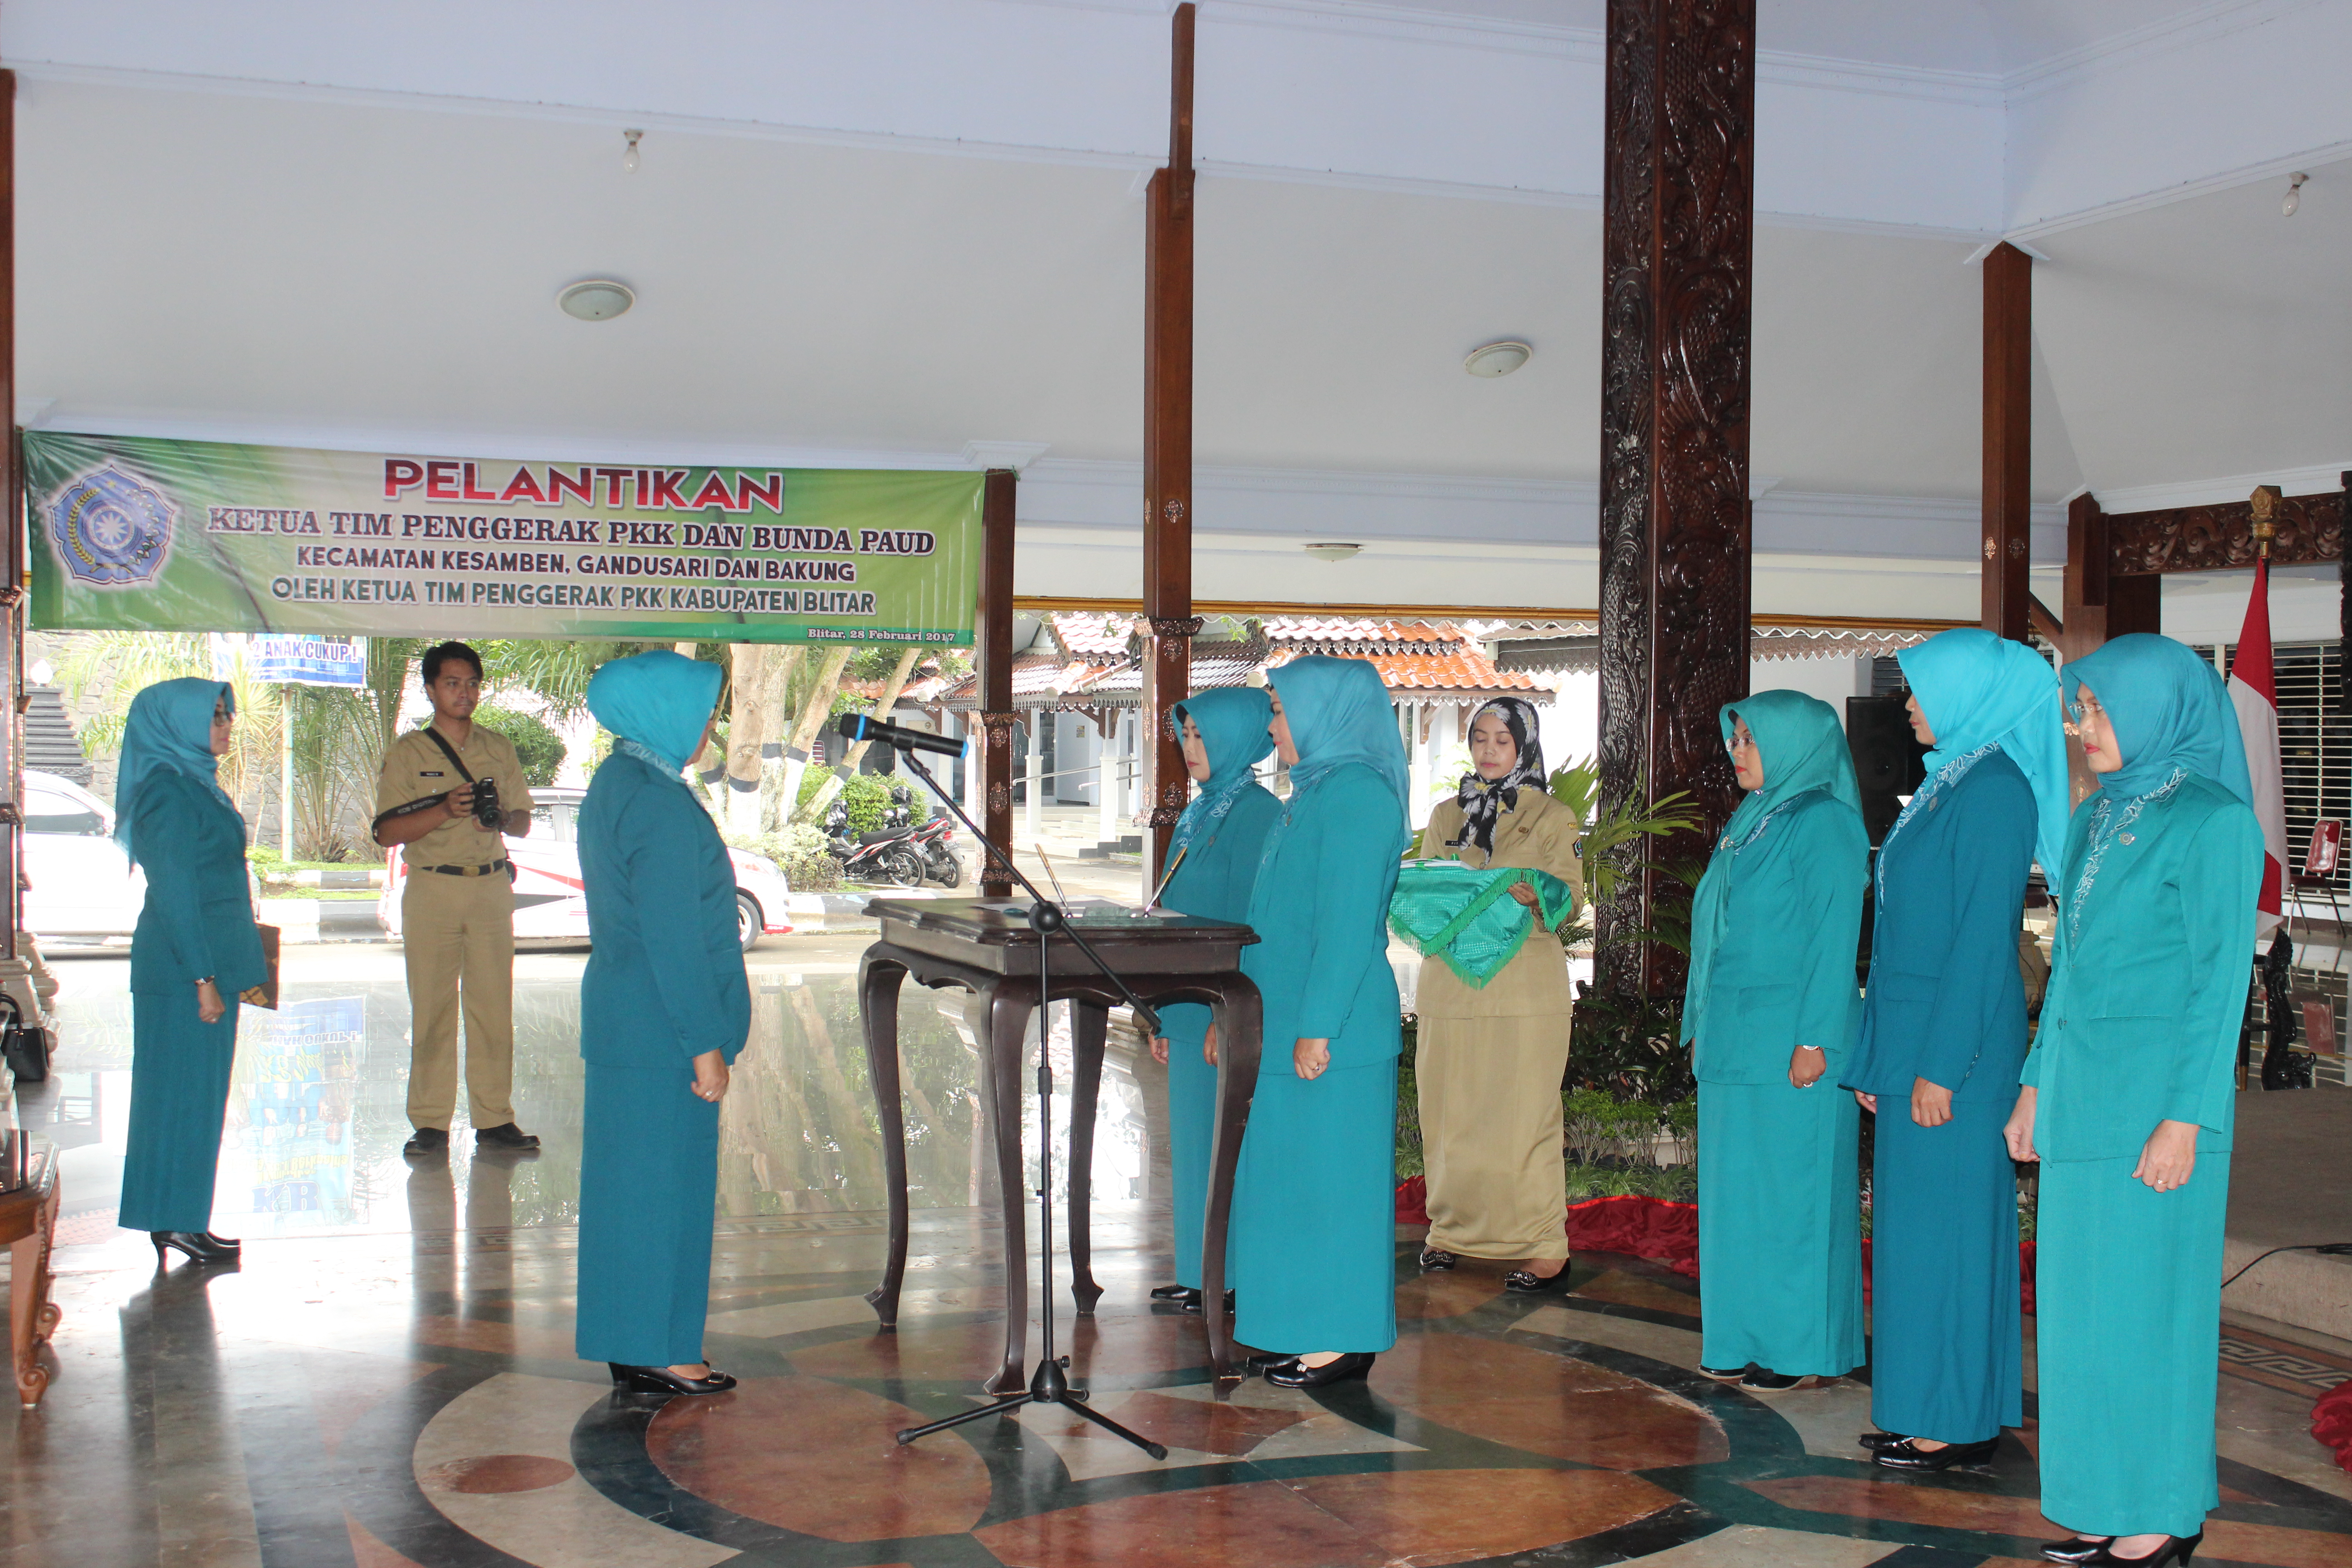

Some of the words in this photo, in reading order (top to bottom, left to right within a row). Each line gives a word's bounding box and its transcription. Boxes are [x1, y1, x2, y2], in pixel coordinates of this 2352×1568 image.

[384, 459, 780, 511] PELANTIKAN
[208, 507, 321, 535] KETUA
[329, 512, 392, 536] TIM
[402, 514, 600, 543] PENGGERAK
[608, 522, 675, 545] PKK
[682, 524, 744, 547] DAN
[752, 527, 853, 551] BUNDA
[860, 530, 934, 553] PAUD
[298, 546, 435, 569] KECAMATAN
[442, 550, 570, 574] KESAMBEN,
[577, 555, 709, 577] GANDUSARI
[715, 559, 760, 578] DAN
[765, 561, 854, 581] BAKUNG
[272, 577, 336, 601] OLEH
[343, 579, 417, 602] KETUA
[425, 581, 465, 603] TIM
[472, 583, 614, 607] PENGGERAK
[621, 587, 665, 608] PKK
[670, 588, 797, 612] KABUPATEN
[804, 591, 874, 612] BLITAR
[253, 642, 260, 657] 2
[265, 641, 302, 657] ANAK
[305, 642, 349, 661] CUKUP
[807, 628, 846, 640] Blitar,
[850, 630, 865, 639] 28
[868, 629, 922, 641] Februari
[926, 632, 956, 642] 2017
